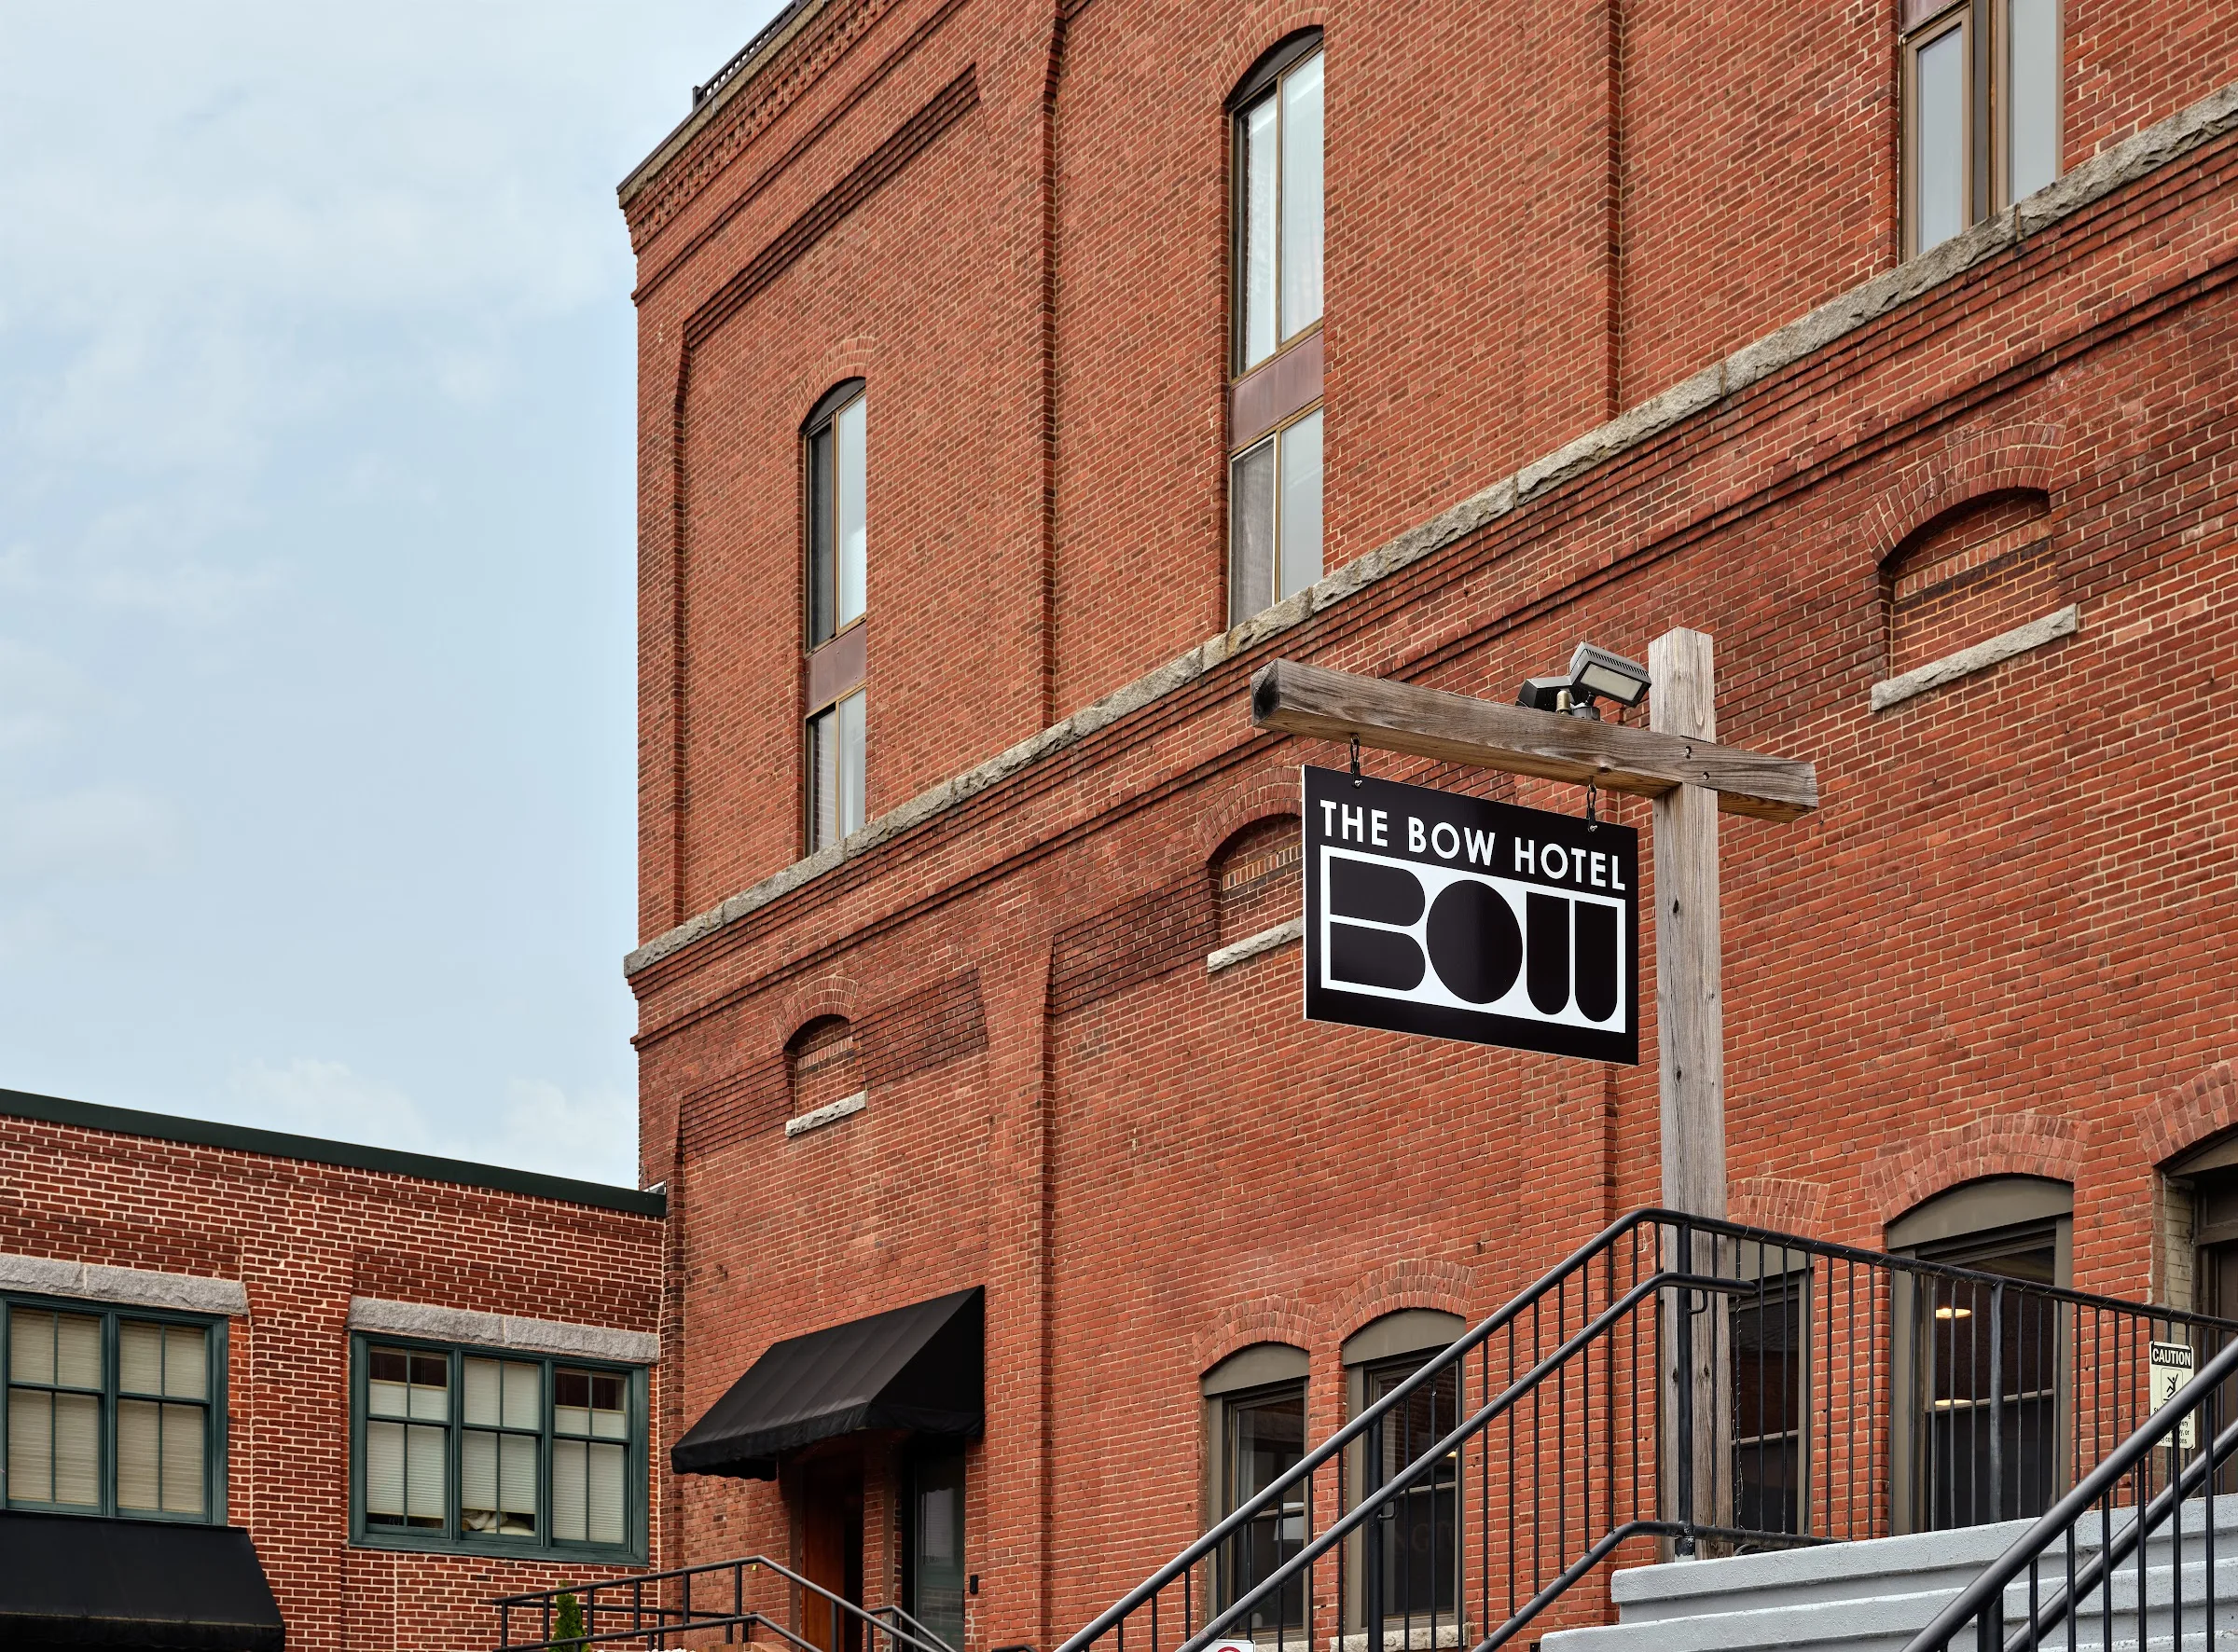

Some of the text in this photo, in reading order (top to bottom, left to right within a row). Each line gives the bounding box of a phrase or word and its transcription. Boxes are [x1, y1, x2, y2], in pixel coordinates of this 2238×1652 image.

[1319, 799, 1625, 890] THE BOW HOTEL
[2152, 1348, 2190, 1367] CAUTION
